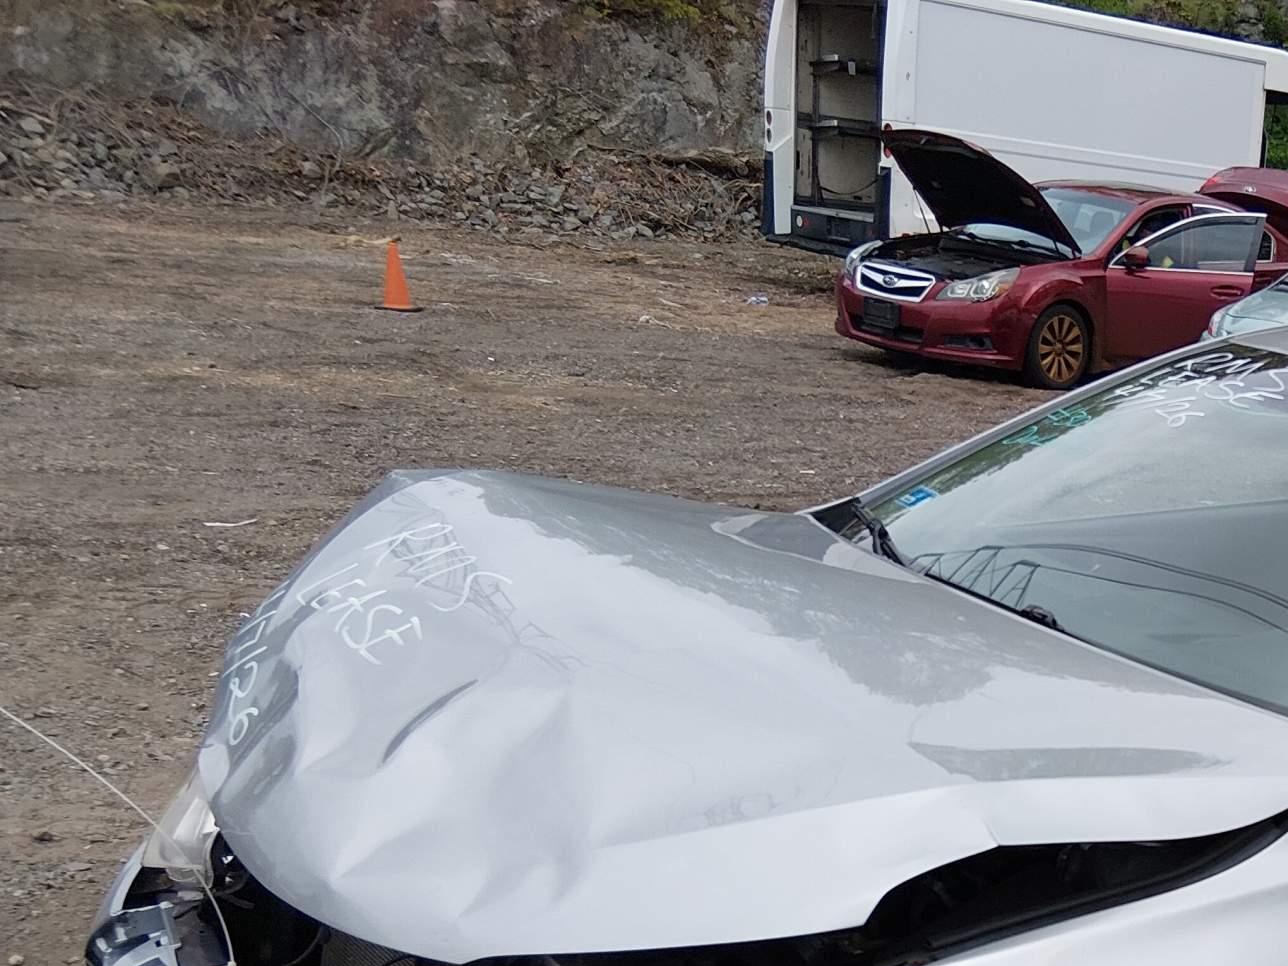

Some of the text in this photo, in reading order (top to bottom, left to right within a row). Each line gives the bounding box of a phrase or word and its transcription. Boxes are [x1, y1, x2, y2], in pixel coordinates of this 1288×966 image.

[1140, 367, 1285, 408] LEASE
[363, 522, 513, 612] RMS
[296, 562, 423, 665] LEASE
